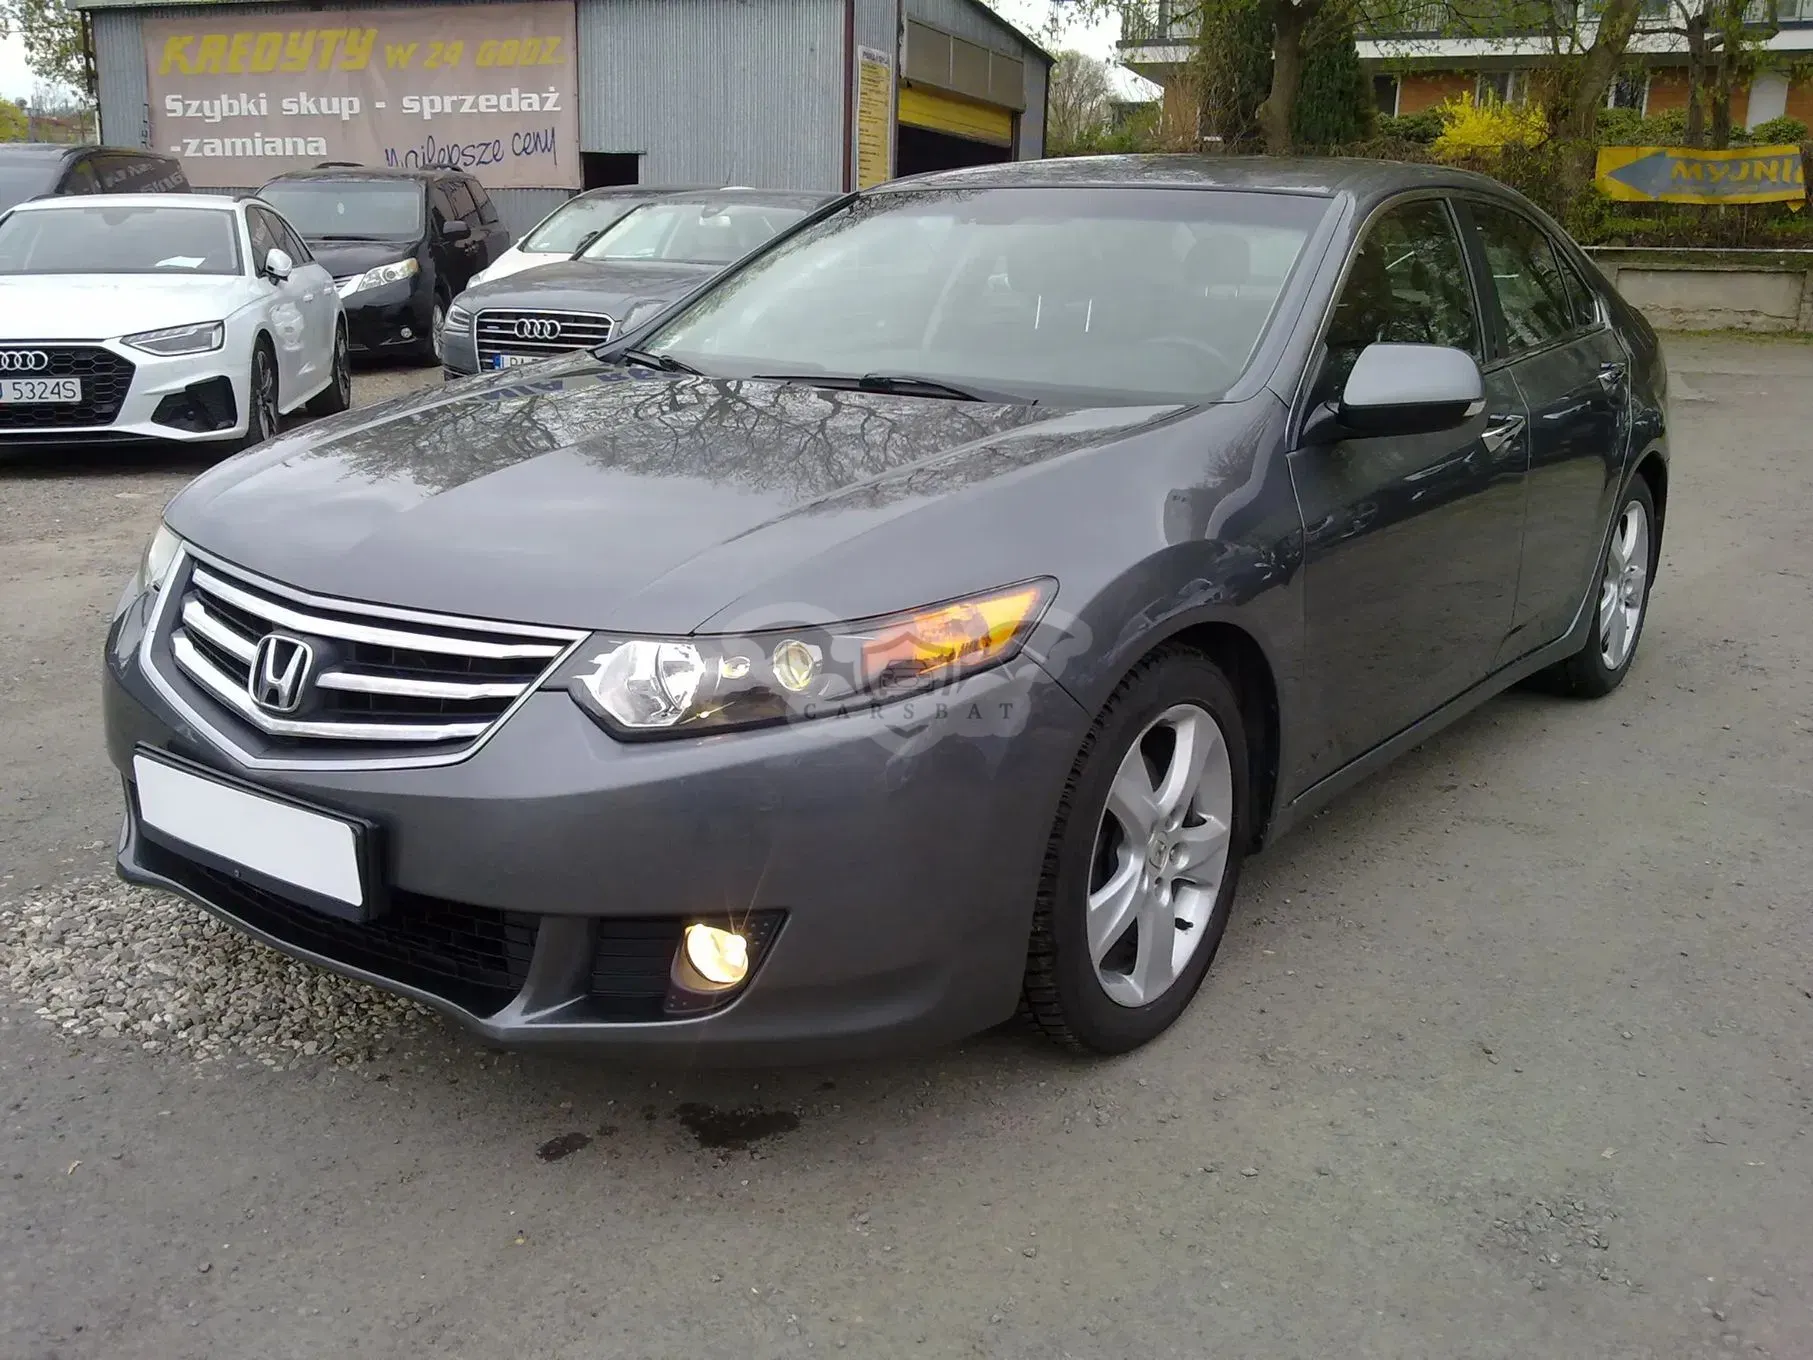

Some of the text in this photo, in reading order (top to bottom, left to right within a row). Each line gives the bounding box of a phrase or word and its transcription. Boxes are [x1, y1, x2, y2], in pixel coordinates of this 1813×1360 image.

[158, 28, 379, 76] KREDYTY
[424, 40, 464, 69] 24
[165, 86, 562, 122] Szybki skup - sprzedaż
[511, 126, 558, 169] ceny
[12, 380, 77, 400] 5324S
